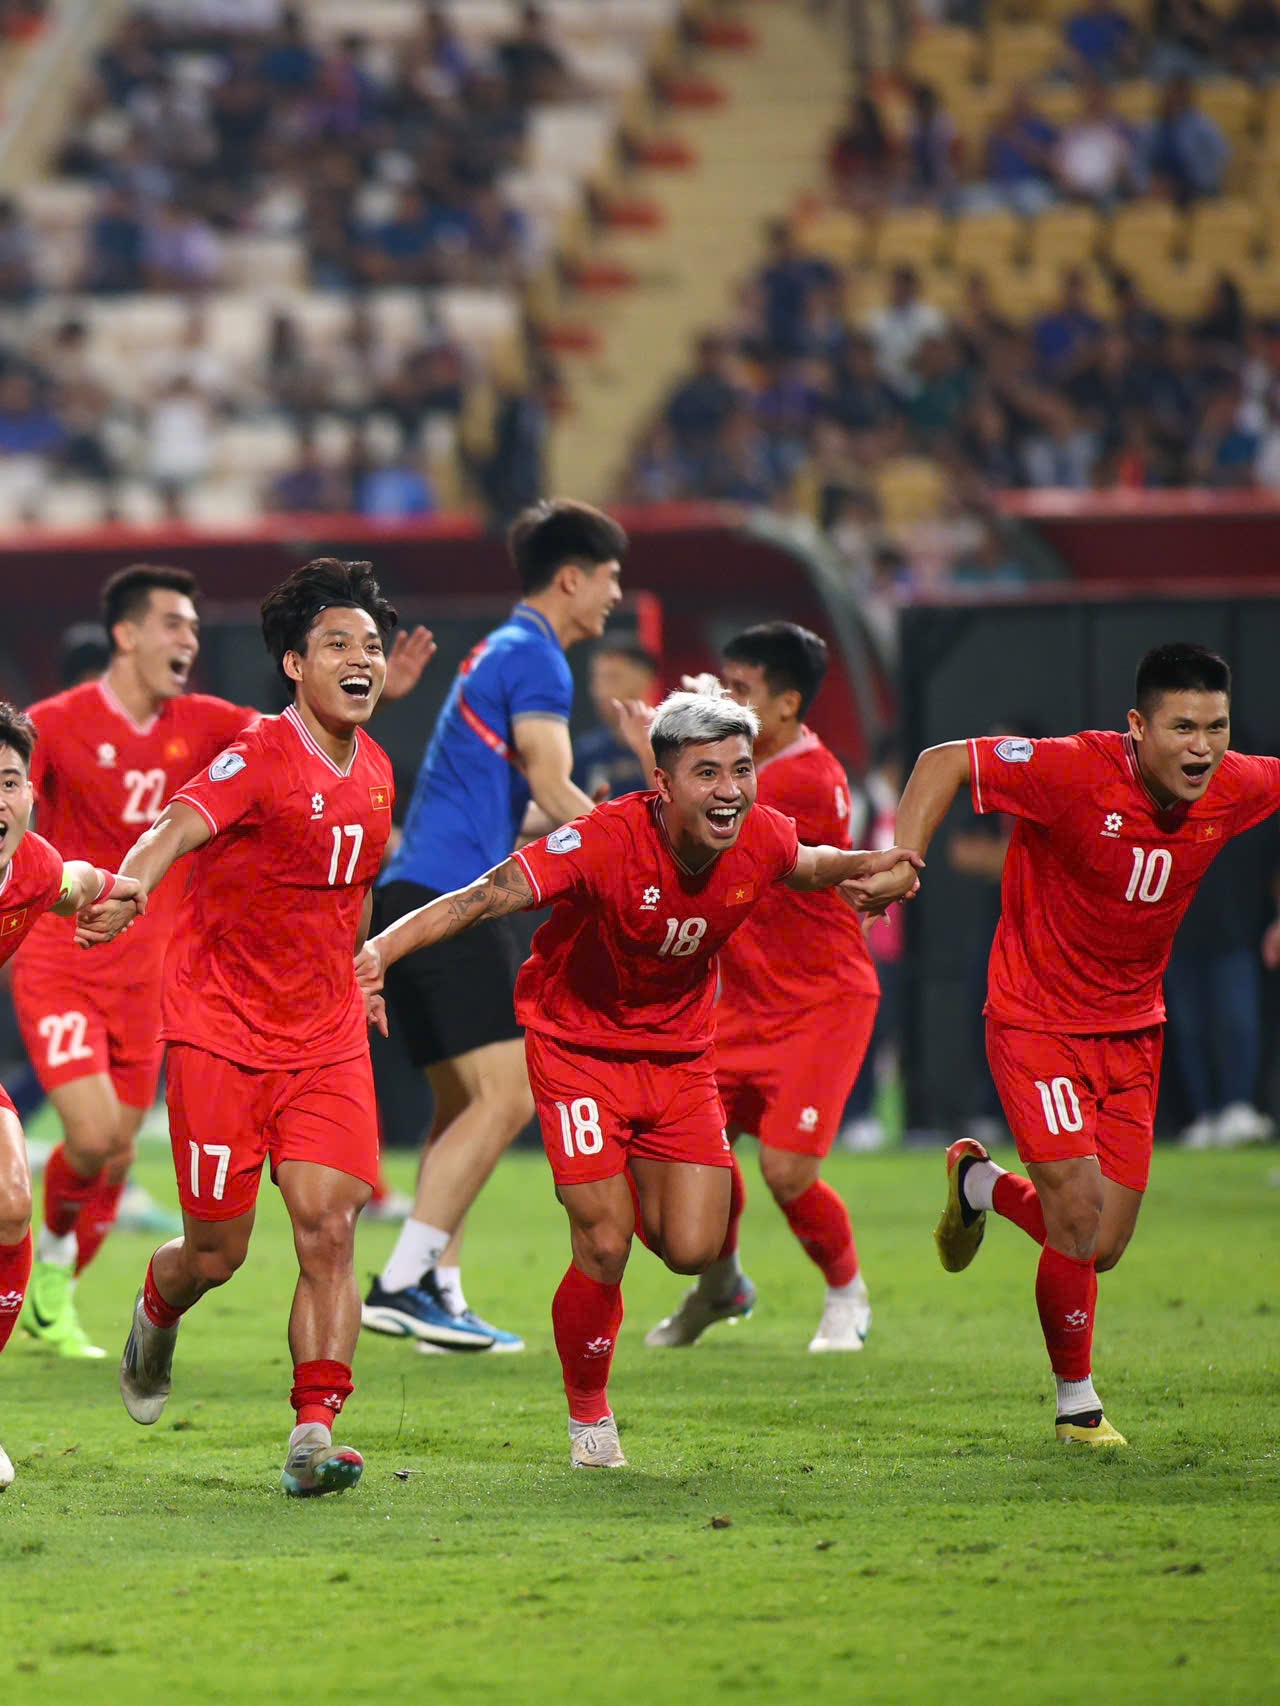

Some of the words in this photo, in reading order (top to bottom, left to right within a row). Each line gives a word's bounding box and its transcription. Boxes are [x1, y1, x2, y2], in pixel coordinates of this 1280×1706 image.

[123, 769, 166, 823] 22
[328, 824, 363, 885] 17
[1126, 847, 1172, 902] 10
[657, 917, 707, 956] 18
[39, 1011, 93, 1067] 22
[556, 1098, 603, 1157] 18
[1035, 1077, 1083, 1135] 10
[189, 1141, 231, 1200] 17
